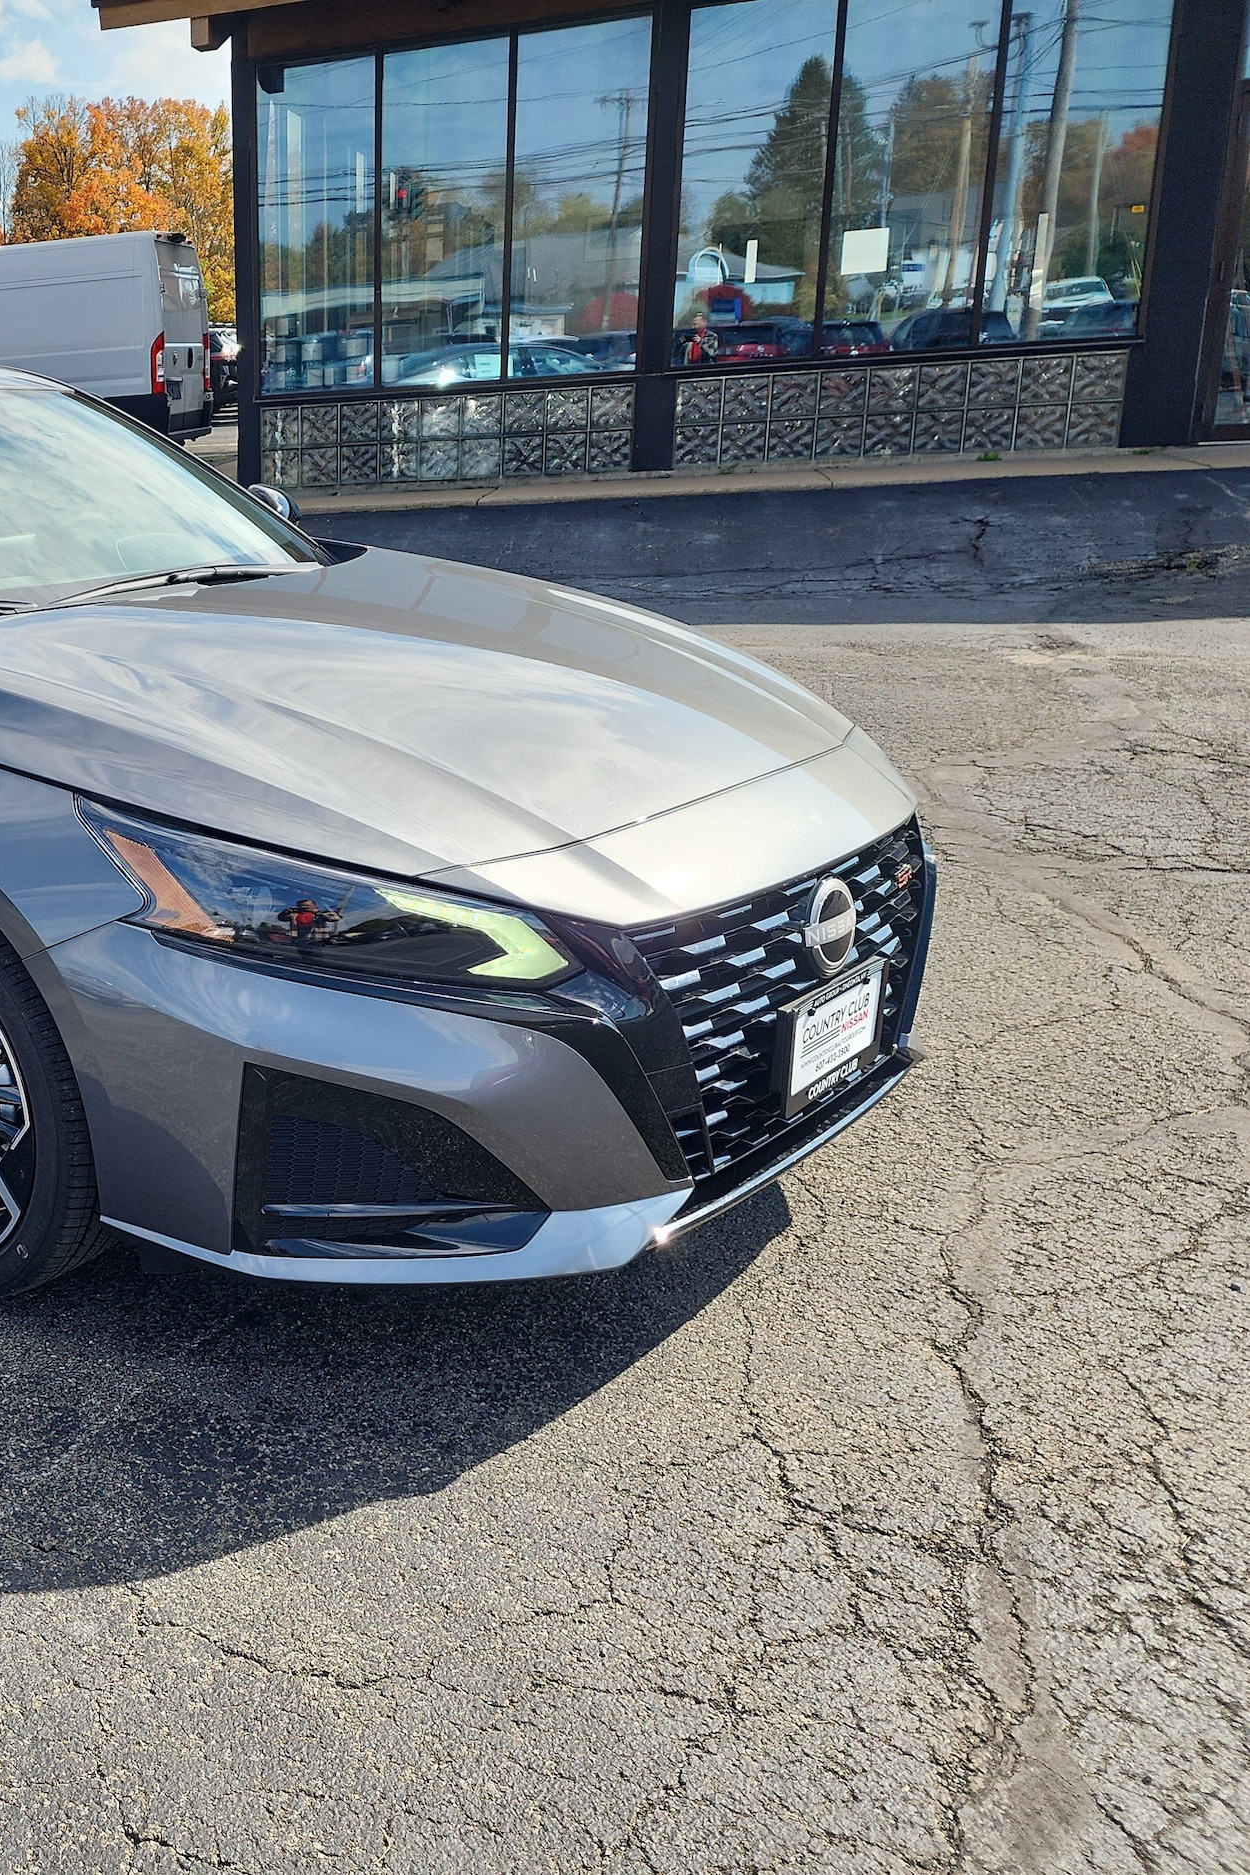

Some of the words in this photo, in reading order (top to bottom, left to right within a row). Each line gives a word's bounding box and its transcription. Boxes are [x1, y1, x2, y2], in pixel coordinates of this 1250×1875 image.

[809, 914, 854, 943] NISSA
[802, 1004, 847, 1044] COUNTRY
[848, 992, 870, 1017] CLUB
[841, 1009, 869, 1033] NISSAN
[808, 1068, 842, 1100] COUNTRY
[840, 1057, 859, 1079] CLUB
